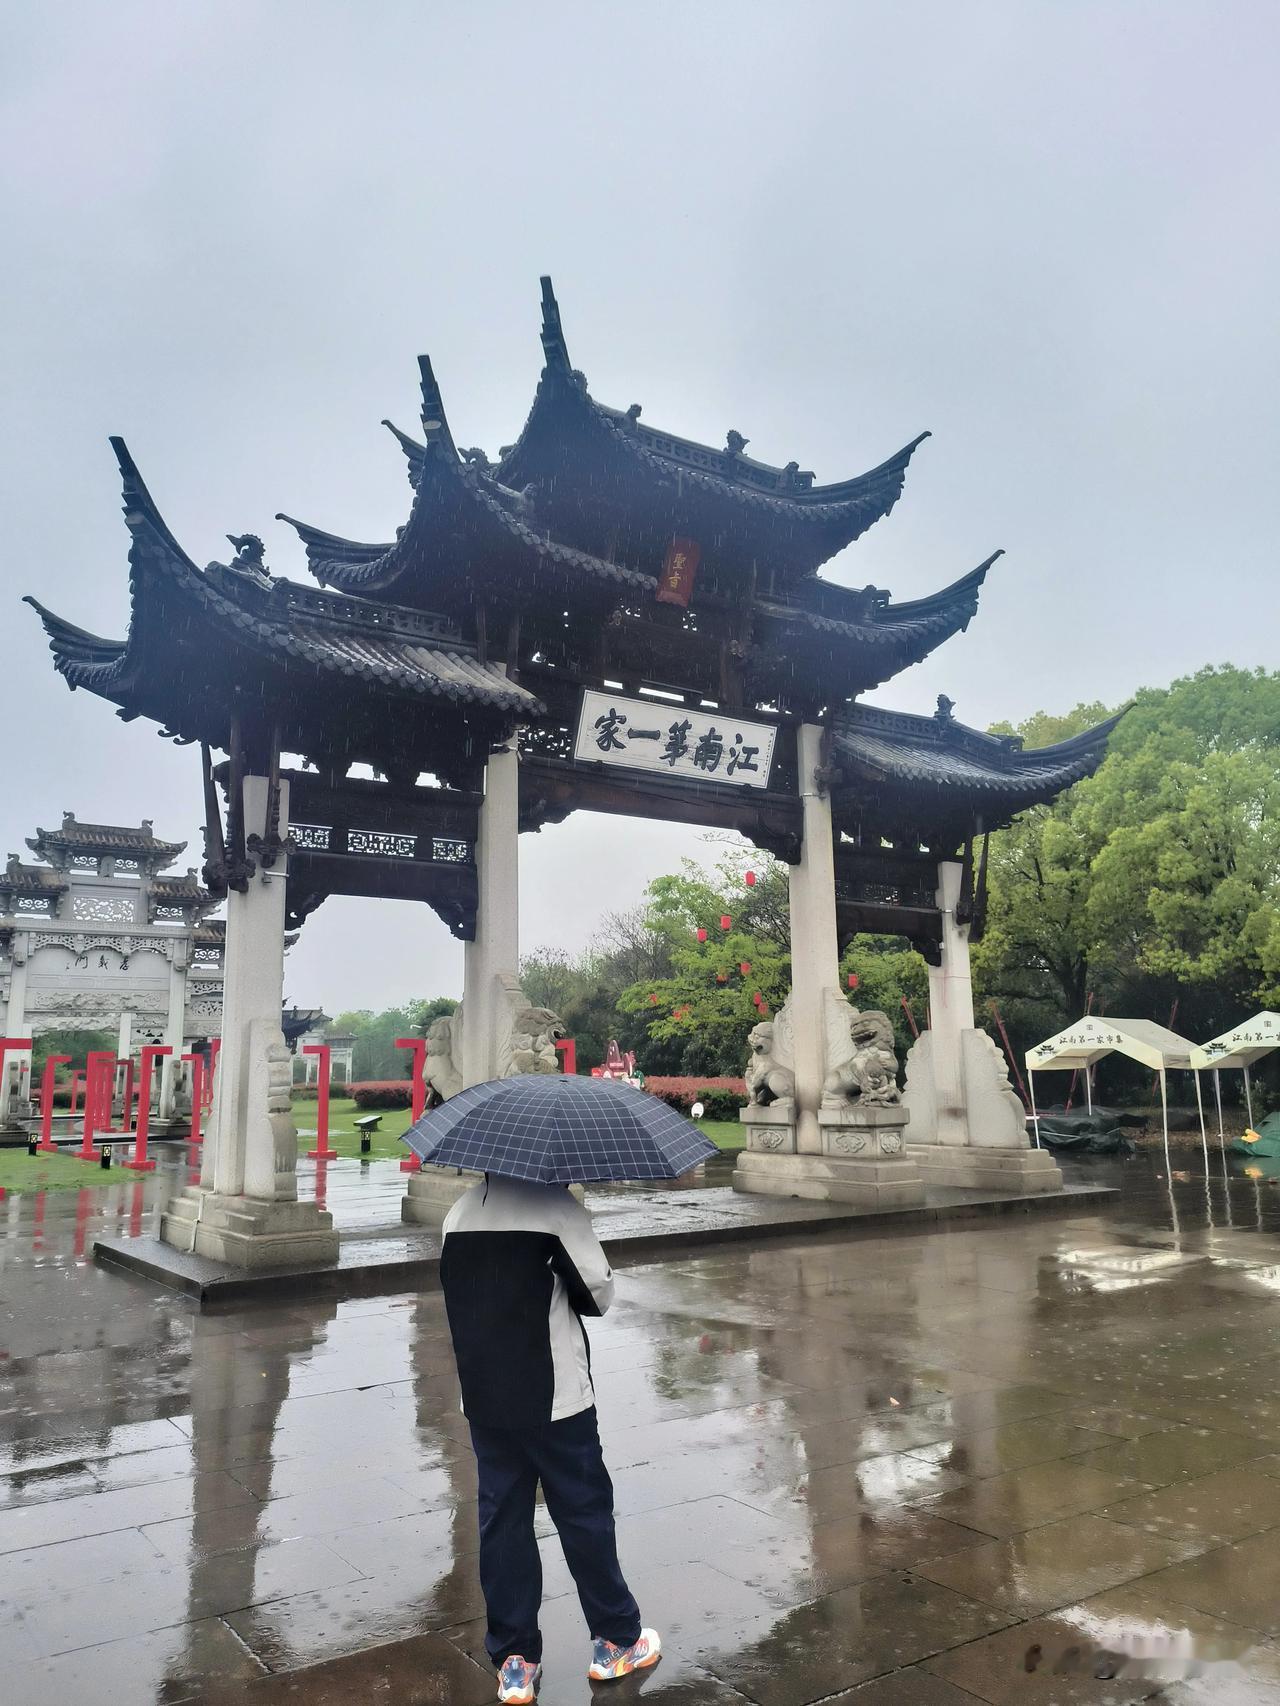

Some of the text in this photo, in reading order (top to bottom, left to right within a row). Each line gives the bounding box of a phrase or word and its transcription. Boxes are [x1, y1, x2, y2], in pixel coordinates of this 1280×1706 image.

[594, 707, 760, 776] 江南第一家
